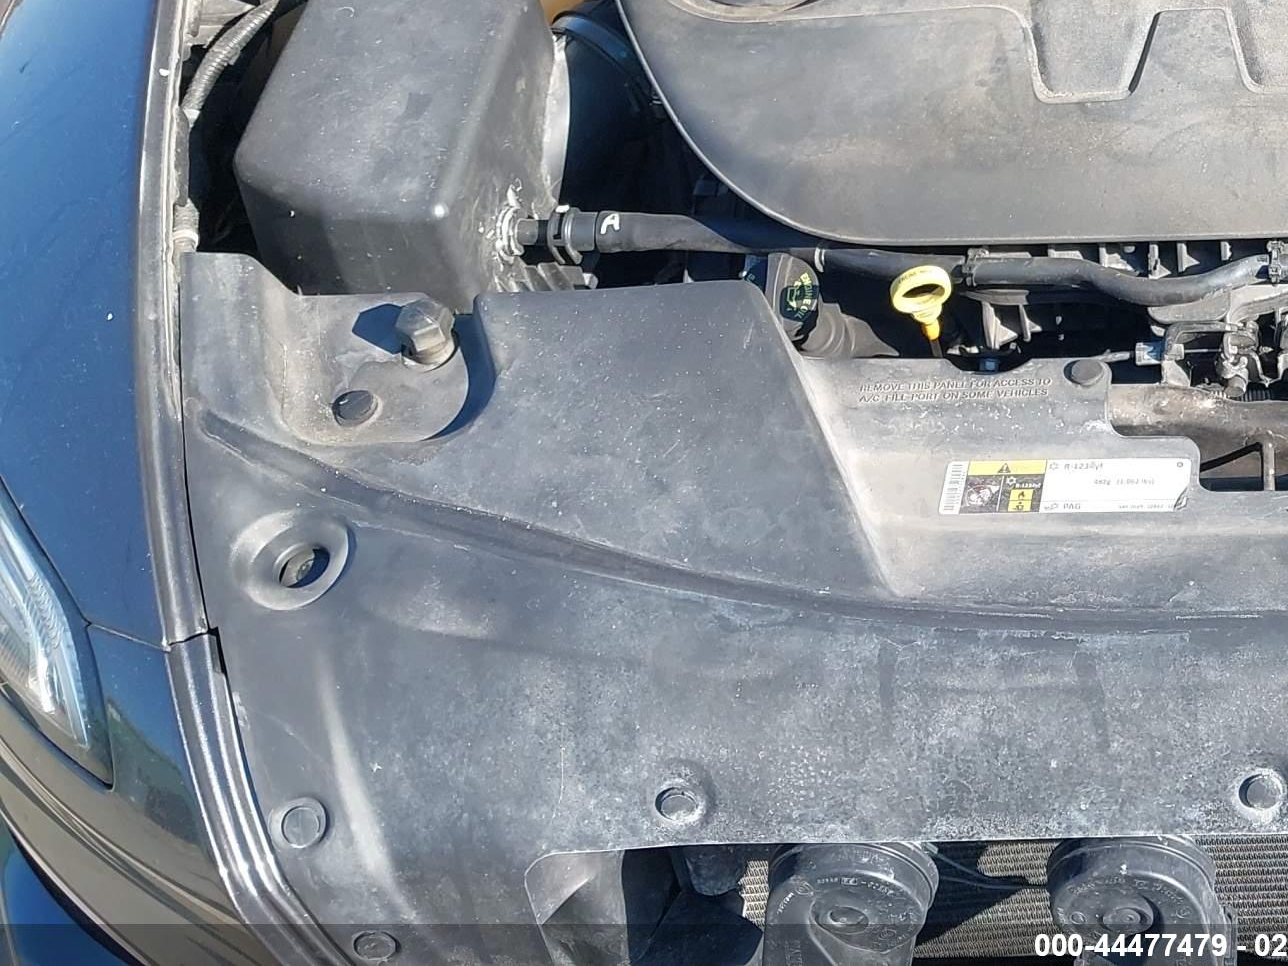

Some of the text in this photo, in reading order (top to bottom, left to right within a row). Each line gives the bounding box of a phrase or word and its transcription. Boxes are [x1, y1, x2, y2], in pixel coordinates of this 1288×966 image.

[600, 213, 620, 235] A
[794, 272, 812, 319] ENGINE OIL
[859, 377, 1051, 392] REMOVE THIS PANEL FOR ACCESS TO
[859, 388, 1048, 403] A/C FILL PORT ON SOME VEHICLES
[1063, 502, 1081, 510] PAG
